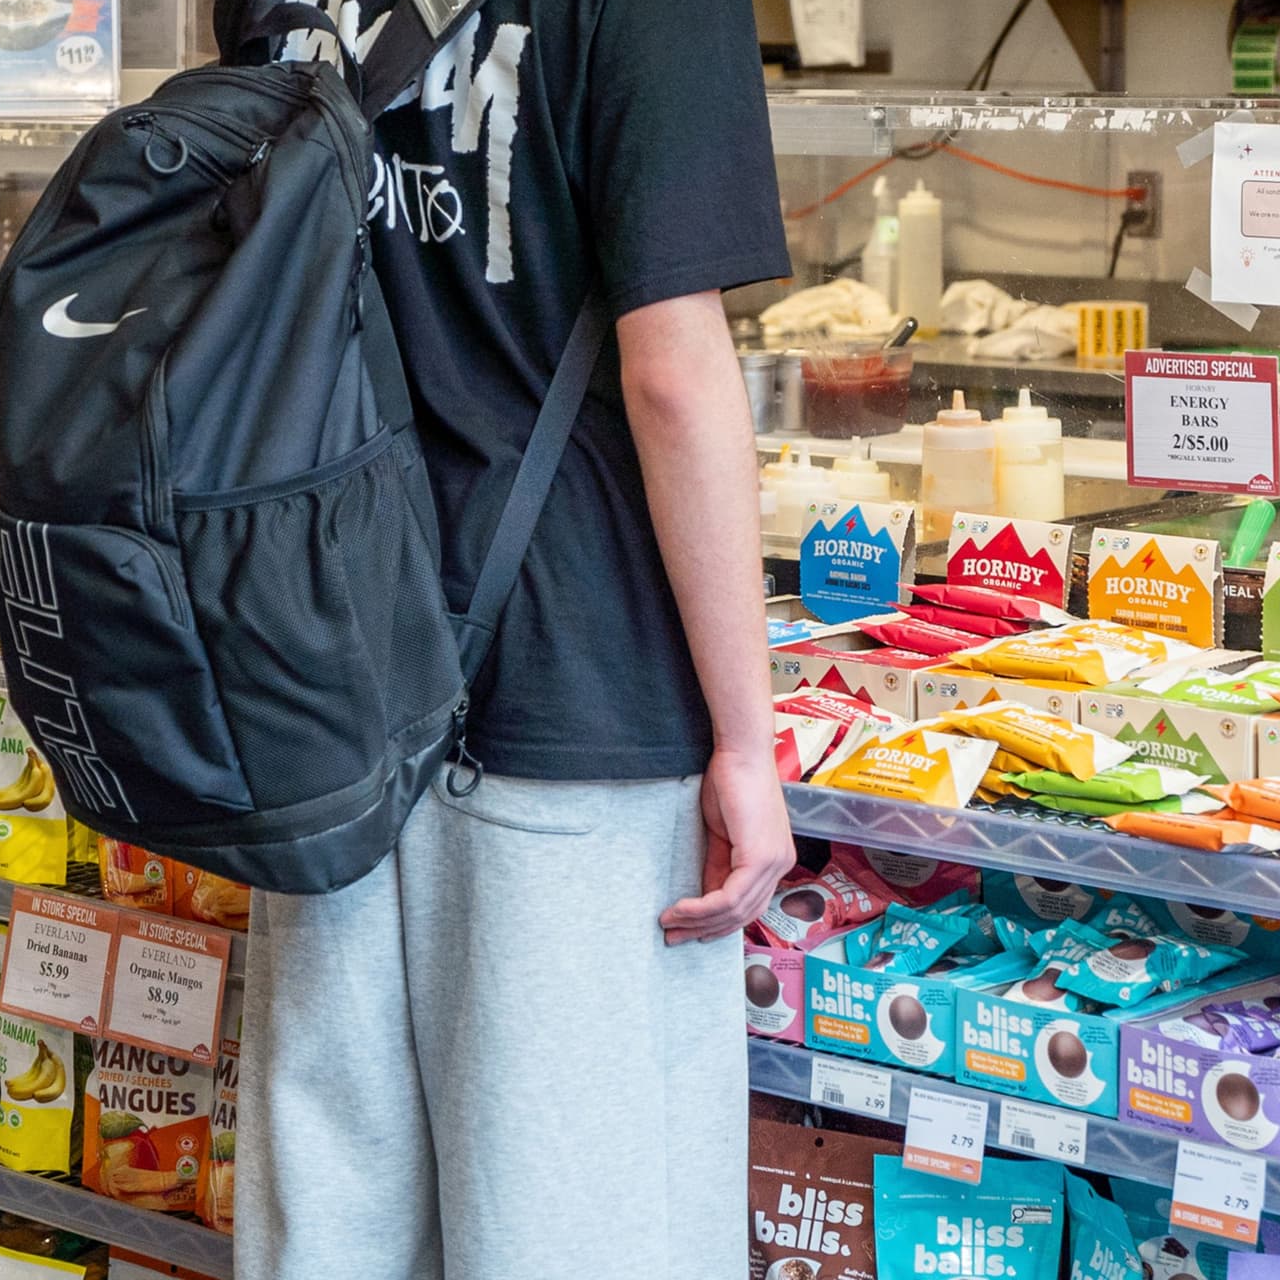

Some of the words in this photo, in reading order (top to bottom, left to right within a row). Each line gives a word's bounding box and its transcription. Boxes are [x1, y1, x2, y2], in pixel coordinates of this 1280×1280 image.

[1145, 357, 1209, 376] ADVERTISED
[1210, 361, 1257, 379] SPECIAL
[1169, 395, 1230, 410] ENERGY
[1181, 414, 1219, 428] BARS
[1172, 433, 1229, 452] 2/$5.00
[814, 540, 885, 564] HORNBY
[831, 558, 864, 569] ORGANIC
[31, 897, 41, 911] IN
[41, 899, 66, 919] STORE
[66, 905, 98, 927] SPECIAL
[34, 922, 86, 945] EVERLAND
[26, 938, 52, 956] Dried
[52, 946, 89, 964] Bananas
[39, 961, 70, 981] $5.99
[823, 970, 875, 1002] bliss
[811, 988, 872, 1022] balls.
[951, 1133, 975, 1149] 2.79
